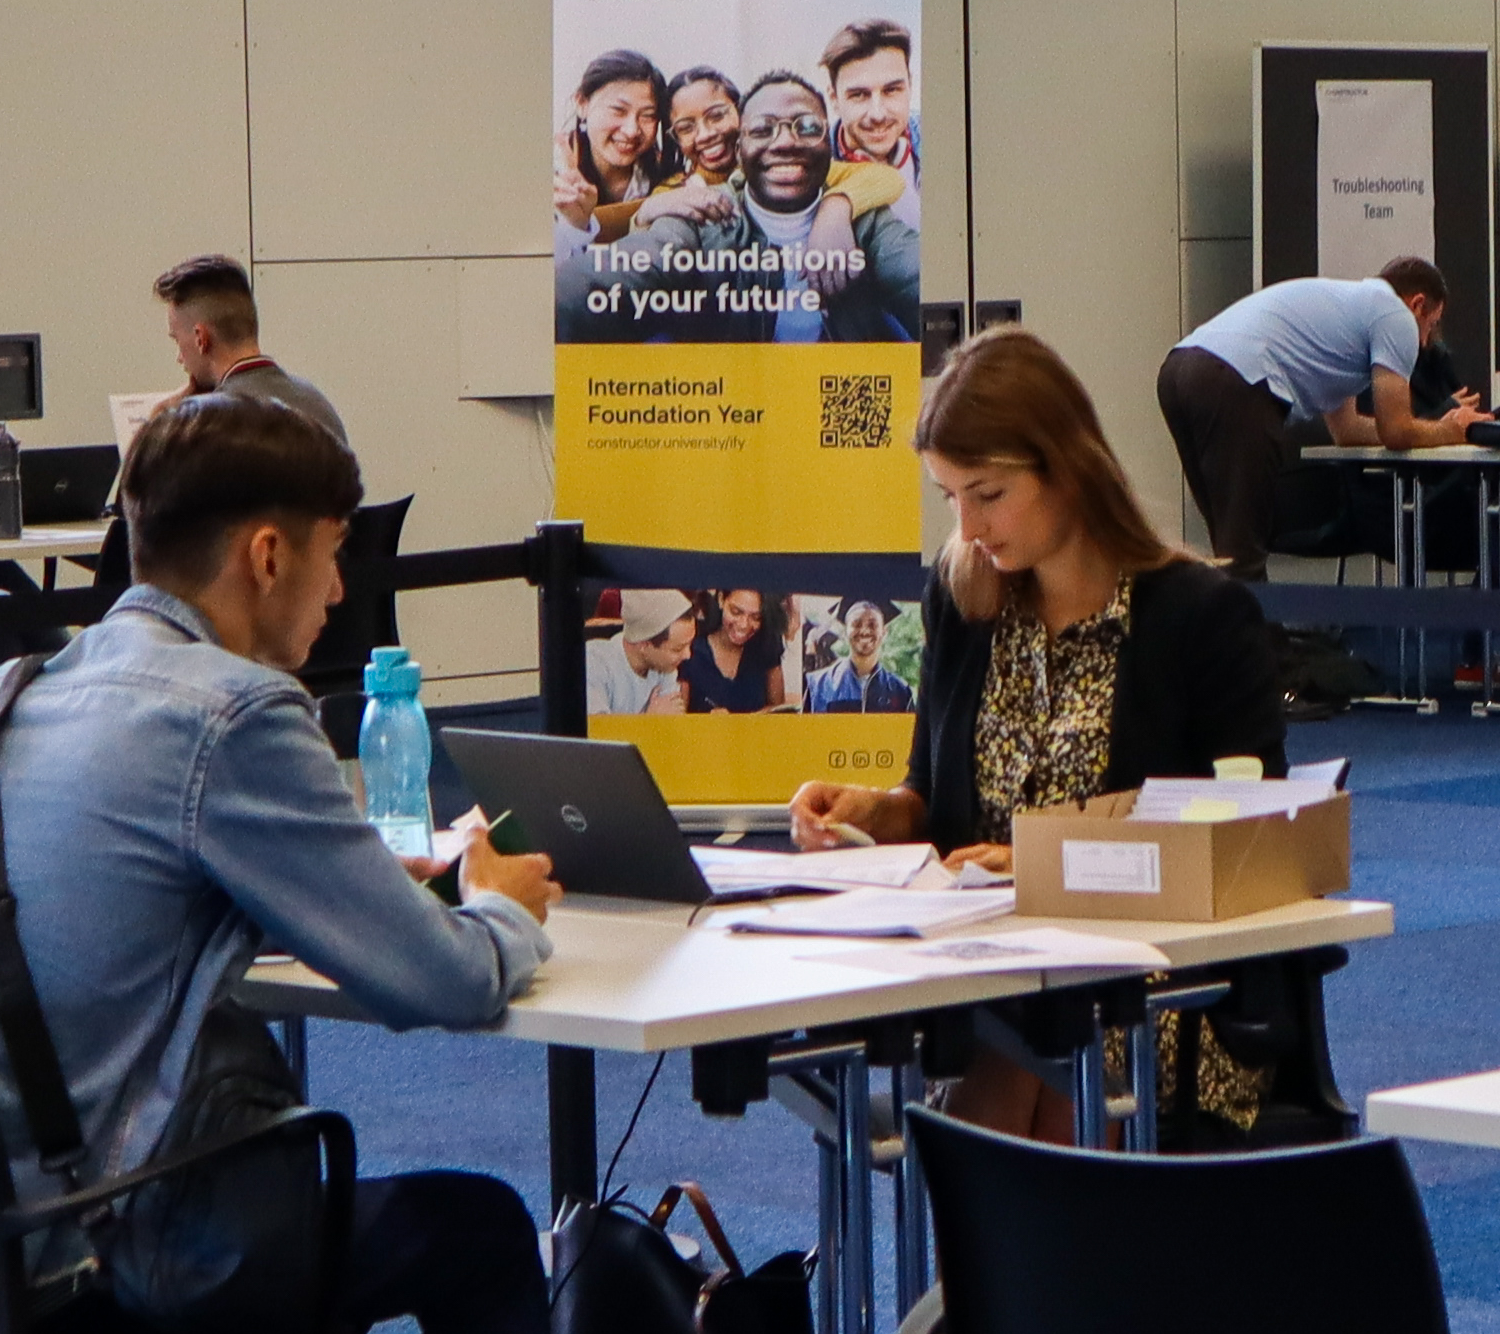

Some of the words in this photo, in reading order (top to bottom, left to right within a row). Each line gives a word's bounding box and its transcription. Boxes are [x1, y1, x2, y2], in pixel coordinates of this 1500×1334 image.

[1332, 177, 1425, 196] Troubleshooting
[1363, 203, 1394, 219] Team
[589, 243, 651, 273] The
[660, 242, 866, 273] foundations
[587, 283, 623, 313] of
[630, 288, 708, 320] your
[715, 283, 821, 313] future
[587, 376, 724, 397] International
[587, 404, 711, 424] Foundation
[716, 404, 765, 424] Year
[586, 435, 746, 451] constructor.university/ify
